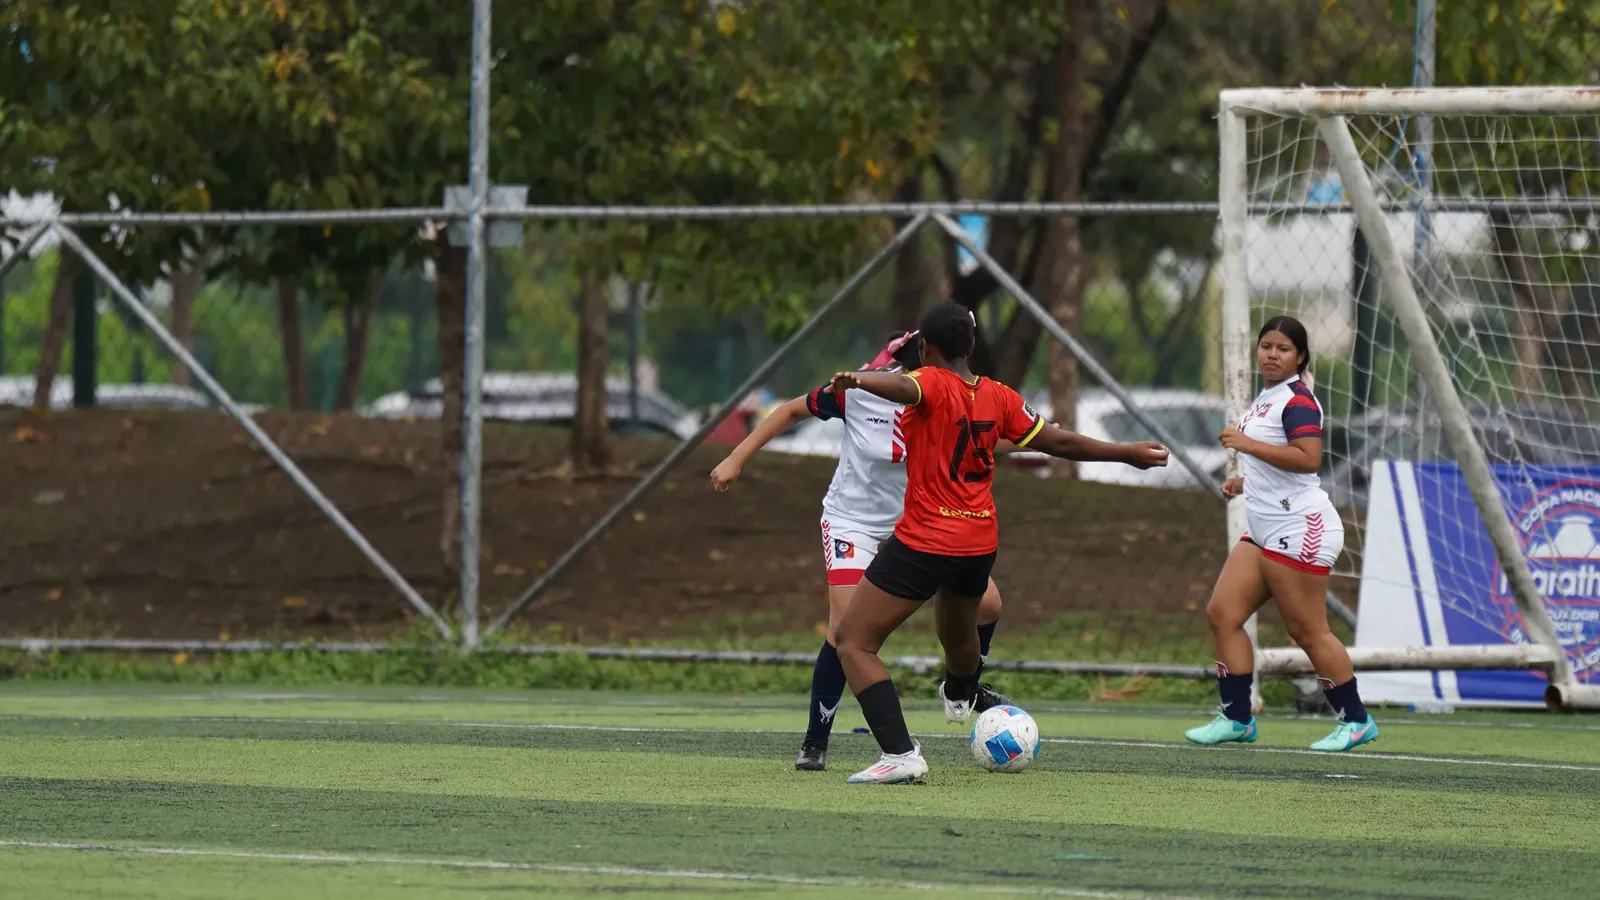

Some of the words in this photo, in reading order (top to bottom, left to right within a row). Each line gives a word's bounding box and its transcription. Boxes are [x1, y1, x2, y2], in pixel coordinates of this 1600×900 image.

[949, 415, 996, 483] 15
[1561, 488, 1600, 508] NACI
[1278, 536, 1289, 550] 5
[1500, 565, 1600, 596] arath
